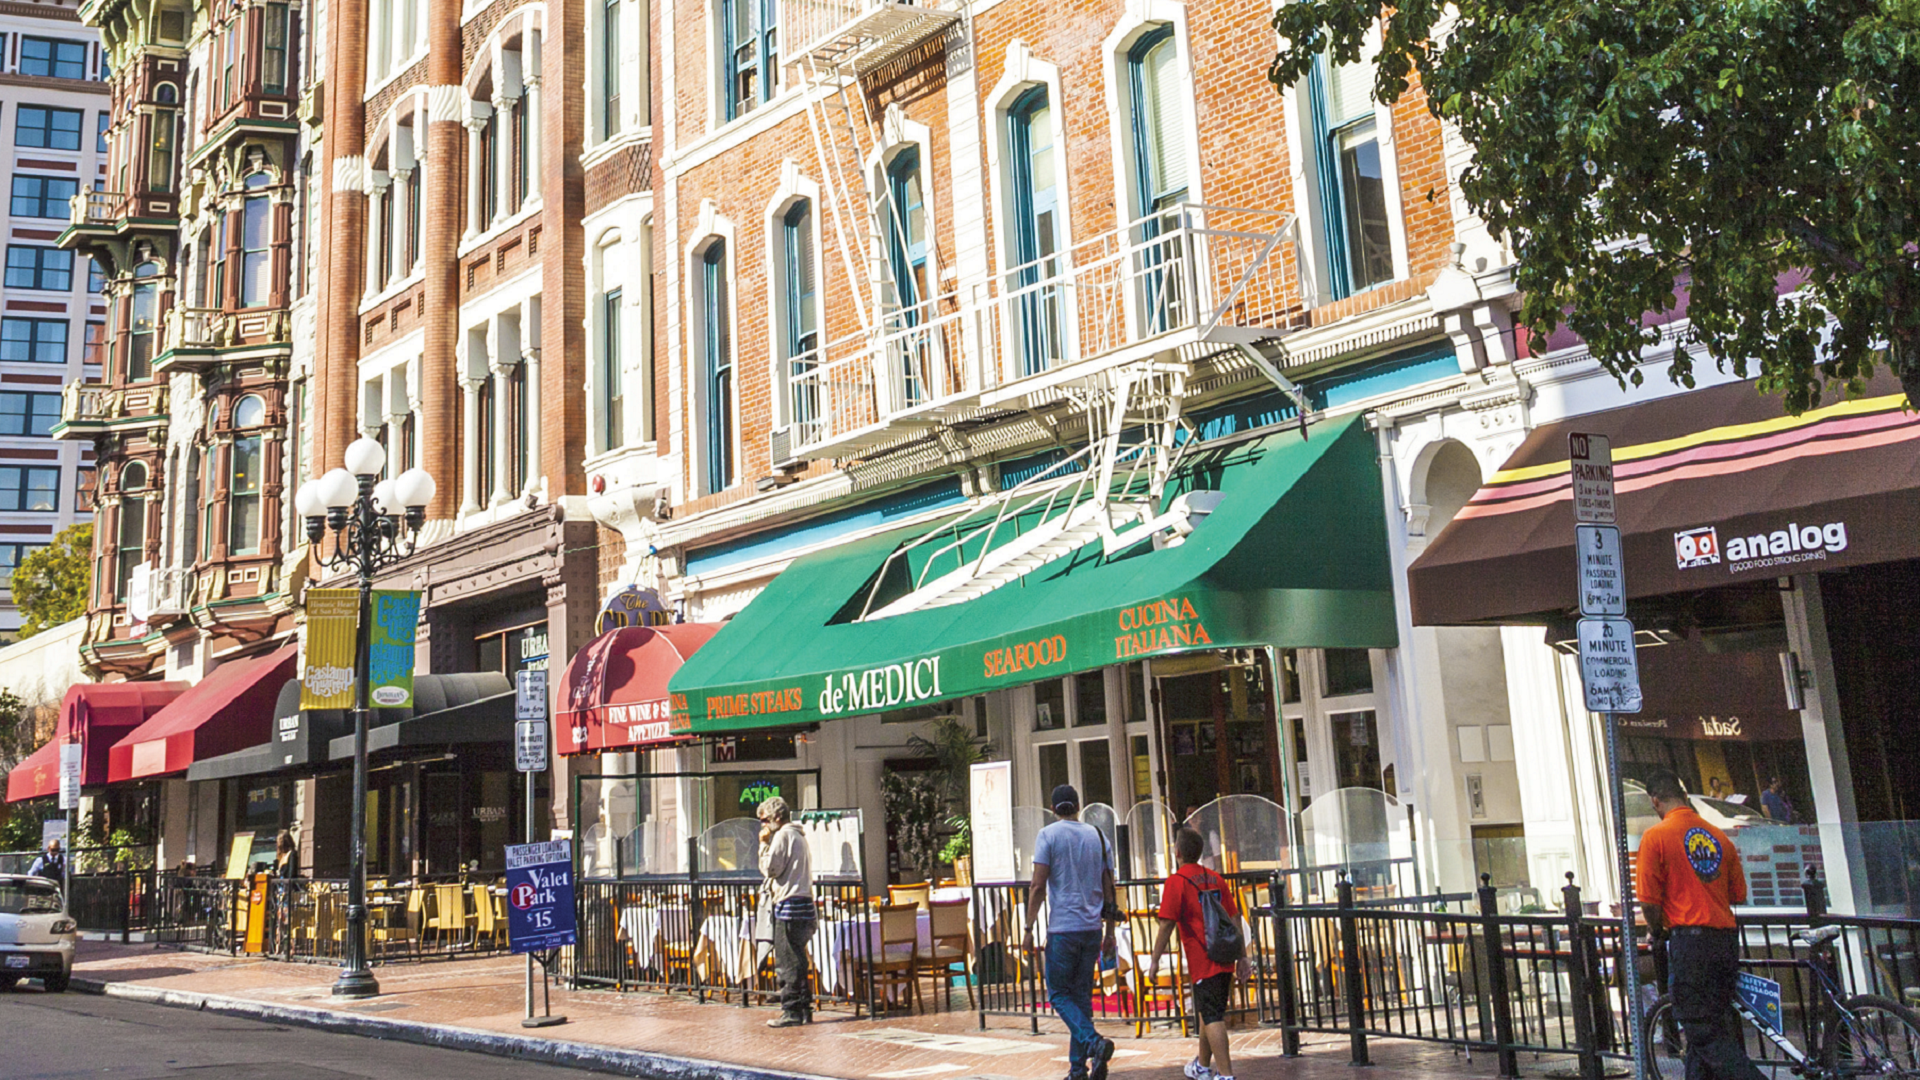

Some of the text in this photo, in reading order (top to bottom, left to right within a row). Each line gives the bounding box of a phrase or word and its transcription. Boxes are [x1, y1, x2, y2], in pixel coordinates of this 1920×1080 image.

[1572, 437, 1586, 456] NO
[1575, 464, 1611, 482] PARKING
[1595, 529, 1603, 550] 3
[1726, 522, 1848, 561] analog
[1587, 554, 1613, 566] MINUTE
[1754, 558, 1774, 568] FOOD
[1773, 554, 1801, 565] STRONG
[1586, 568, 1617, 579] PASSENGER
[1591, 579, 1614, 589] LOADING
[337, 600, 355, 608] Heart
[620, 593, 648, 611] The
[1118, 597, 1199, 631] CUCINA
[1603, 624, 1613, 637] 20
[521, 633, 550, 659] URBA
[1115, 622, 1213, 659] ITALIANA
[1589, 640, 1627, 653] MINUTE
[983, 634, 1067, 678] SEAFOOD
[1585, 656, 1632, 666] COMMERCIAL
[305, 662, 353, 691] Gaslamp
[1594, 668, 1627, 678] LOADING
[818, 656, 942, 715] de'MEDICI
[608, 706, 627, 724] FINE
[628, 703, 652, 722] WINE
[653, 702, 659, 719] &
[707, 694, 751, 720] PRIME
[750, 688, 803, 716] STEAKS
[520, 735, 543, 743] MNUTE
[572, 726, 588, 744] 823
[628, 721, 671, 742] APPETIZER
[739, 785, 780, 803] ATM
[472, 806, 506, 816] URBAN
[512, 841, 563, 856] PASSENGER LOADING
[508, 850, 571, 868] VALET PARKING OPTIONAL
[527, 868, 568, 889] Valet
[517, 885, 556, 907] Park
[1750, 993, 1757, 1005] 7
